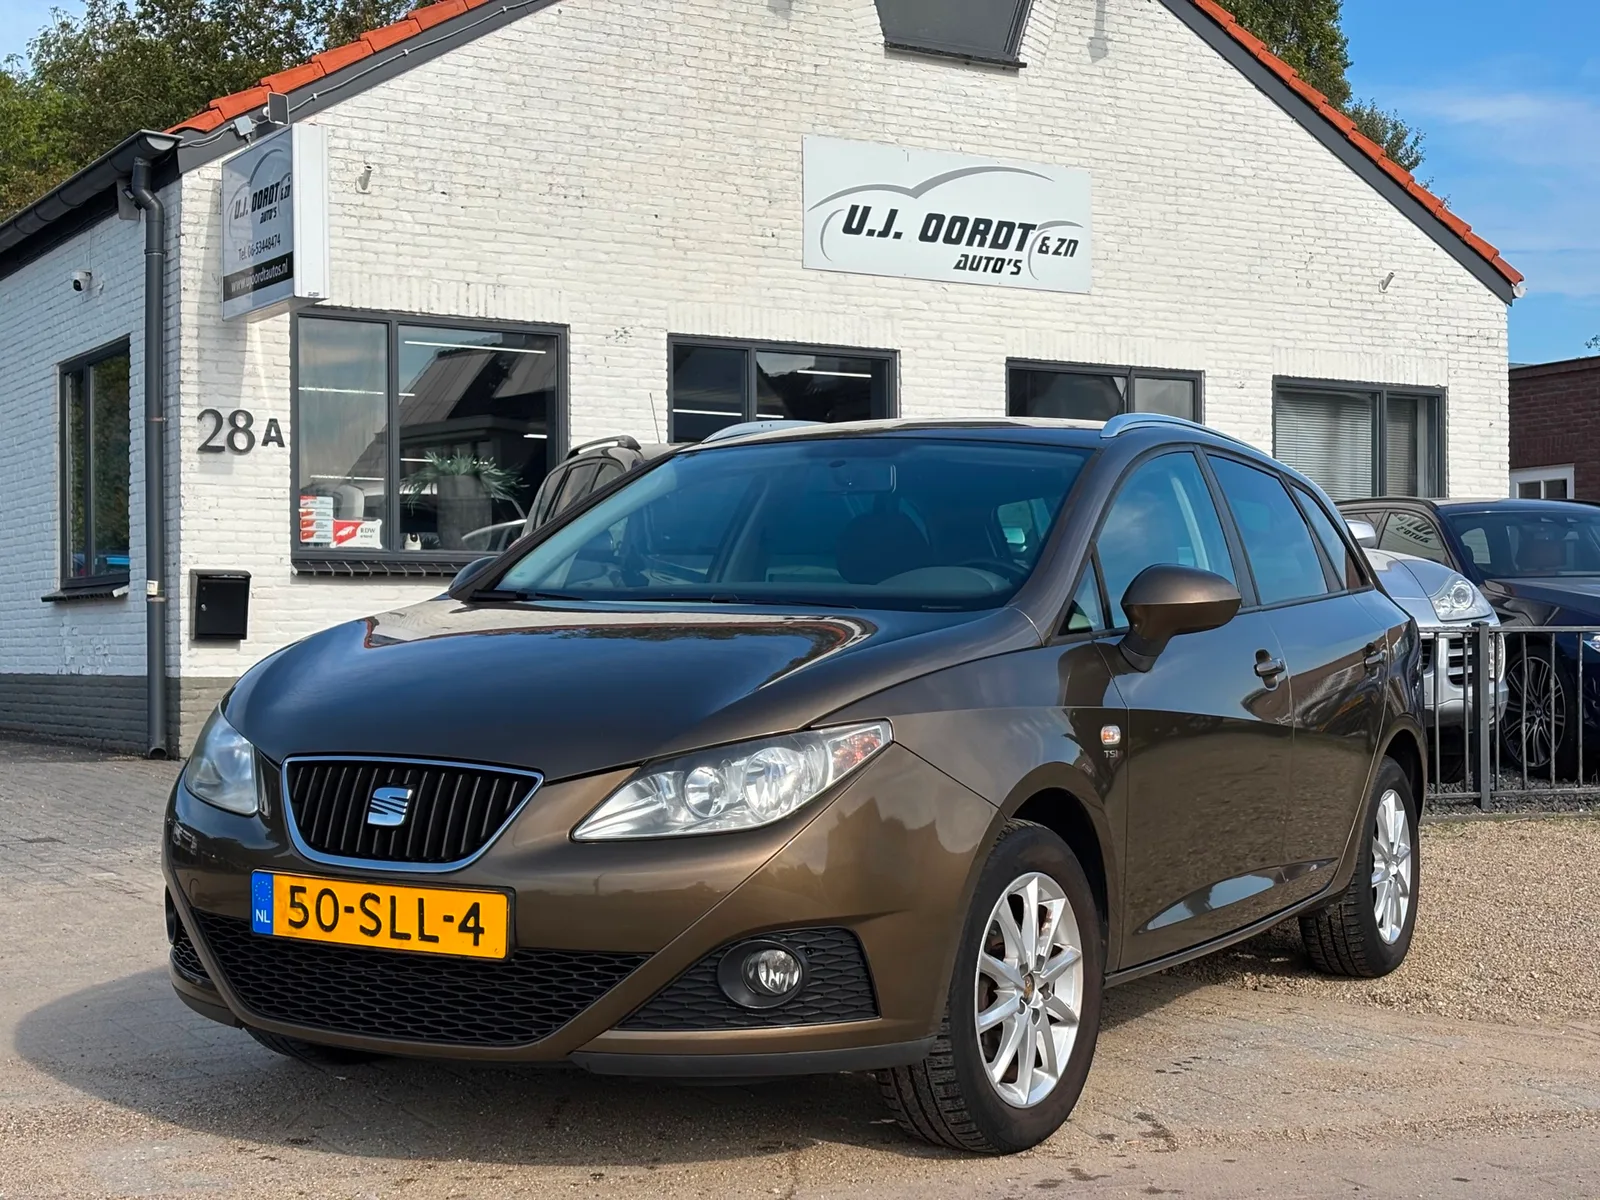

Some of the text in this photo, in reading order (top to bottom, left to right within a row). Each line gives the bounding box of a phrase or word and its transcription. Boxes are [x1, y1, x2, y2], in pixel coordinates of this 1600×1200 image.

[251, 182, 280, 212] OORDT
[842, 204, 903, 240] U.J.
[918, 212, 1038, 252] OORDT
[1037, 236, 1051, 255] &
[953, 253, 1023, 276] AUTO'S
[197, 408, 285, 453] 28 A
[1104, 750, 1118, 758] TSI
[255, 909, 271, 924] NL
[288, 885, 485, 947] 50-SLL-4
